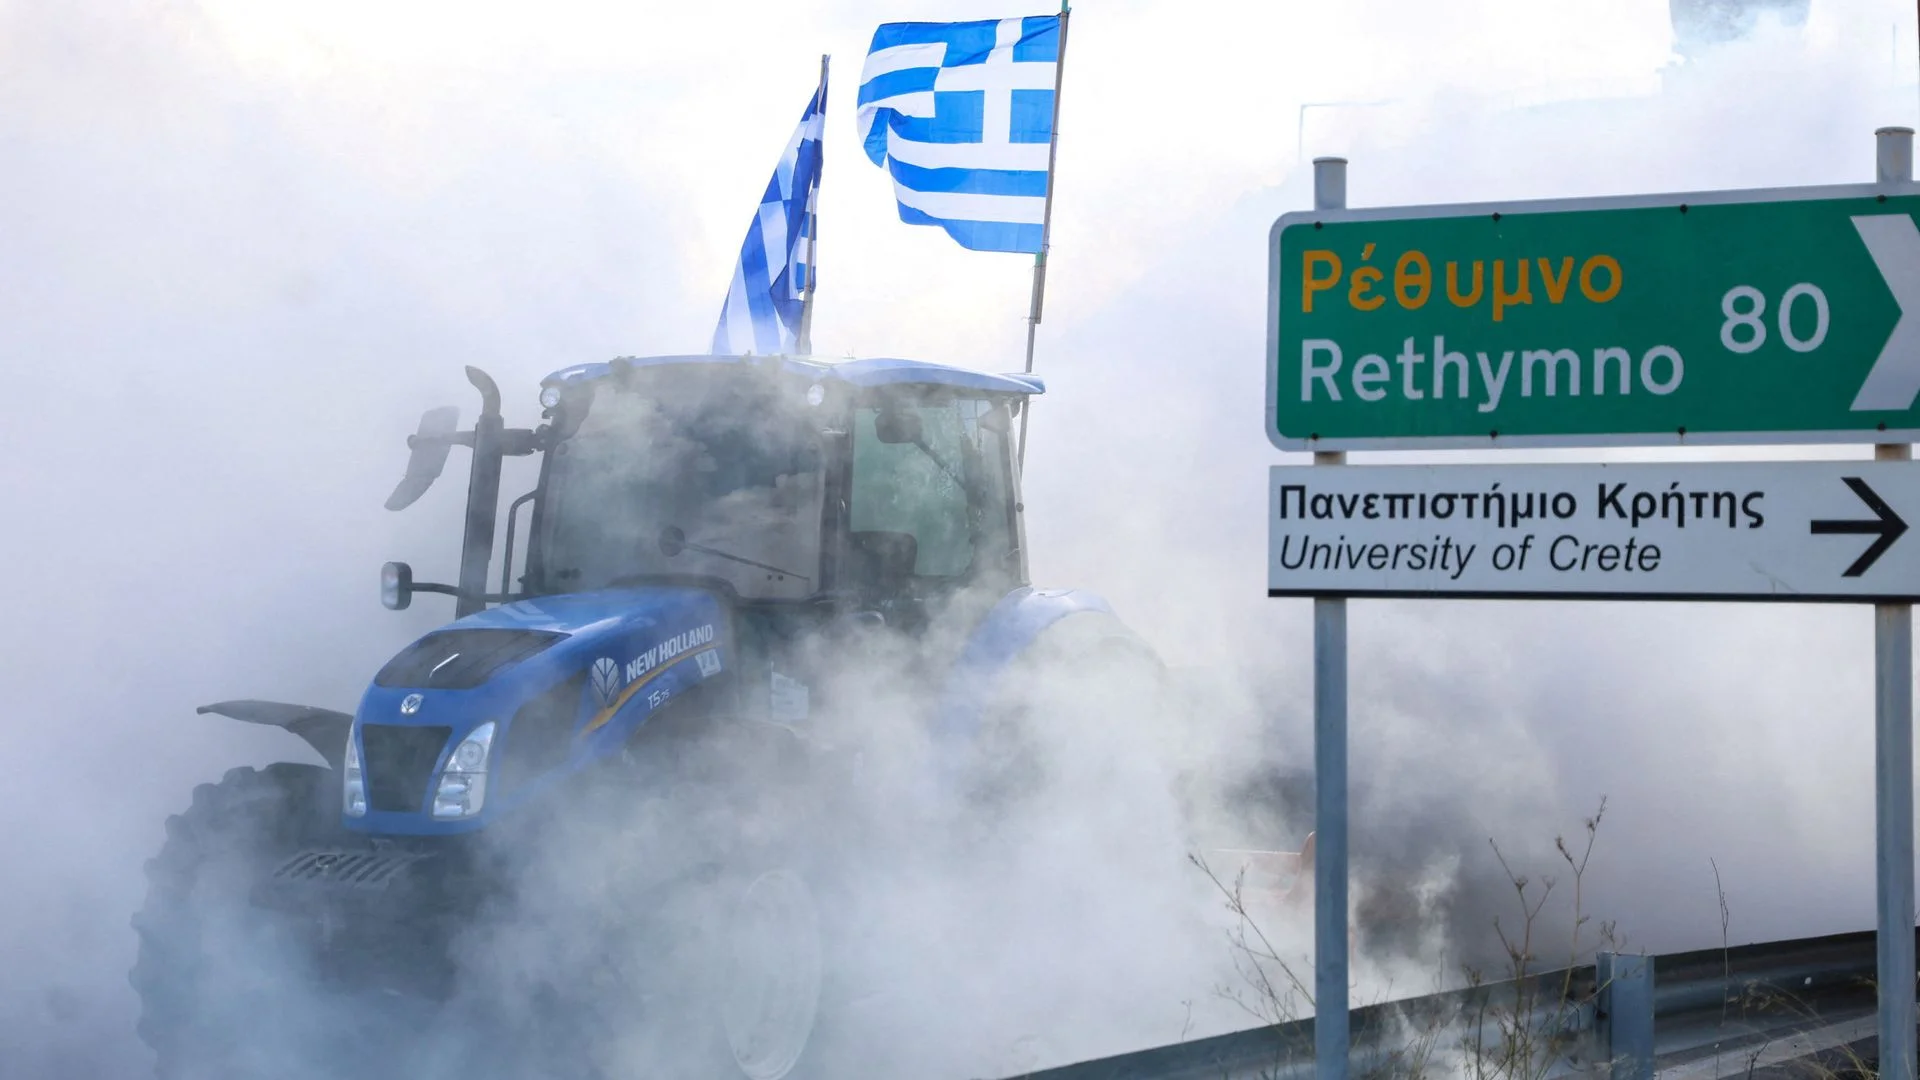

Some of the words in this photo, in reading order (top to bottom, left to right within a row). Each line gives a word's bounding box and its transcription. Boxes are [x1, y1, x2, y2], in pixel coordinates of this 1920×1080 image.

[1302, 244, 1622, 321] Ρέθυμνο
[1720, 282, 1830, 353] 80
[1301, 336, 1684, 412] Rethymno
[1280, 482, 1577, 529] Πανεπιστήμιο
[1598, 482, 1765, 529] Κρήτης
[1280, 535, 1477, 581] University
[1491, 535, 1535, 572] of
[1549, 535, 1662, 573] Crete
[626, 647, 657, 684] NEW
[659, 624, 713, 662] HOLLAND
